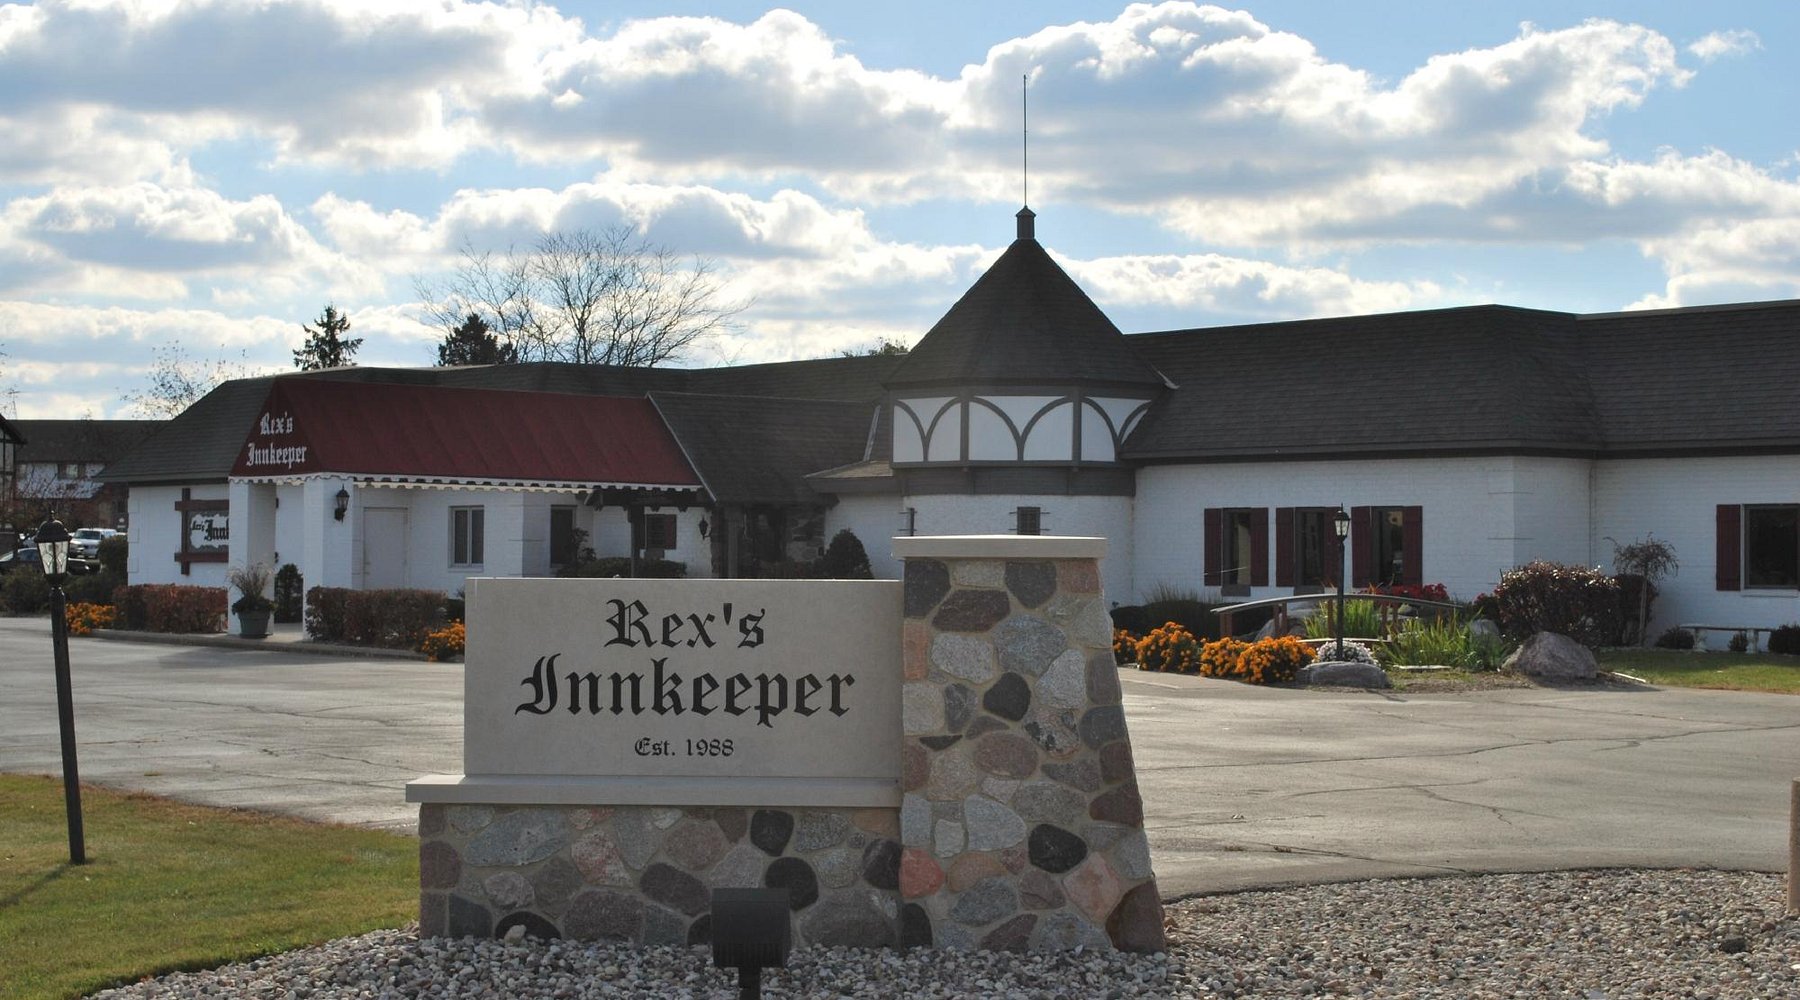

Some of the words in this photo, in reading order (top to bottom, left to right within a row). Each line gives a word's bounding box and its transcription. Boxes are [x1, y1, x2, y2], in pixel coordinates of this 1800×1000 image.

[260, 411, 293, 435] Rex's
[246, 442, 308, 469] Innkeeper
[603, 598, 766, 649] Rex's
[514, 652, 856, 729] Innkeeper
[634, 736, 676, 757] Est.
[686, 738, 735, 757] 1988
